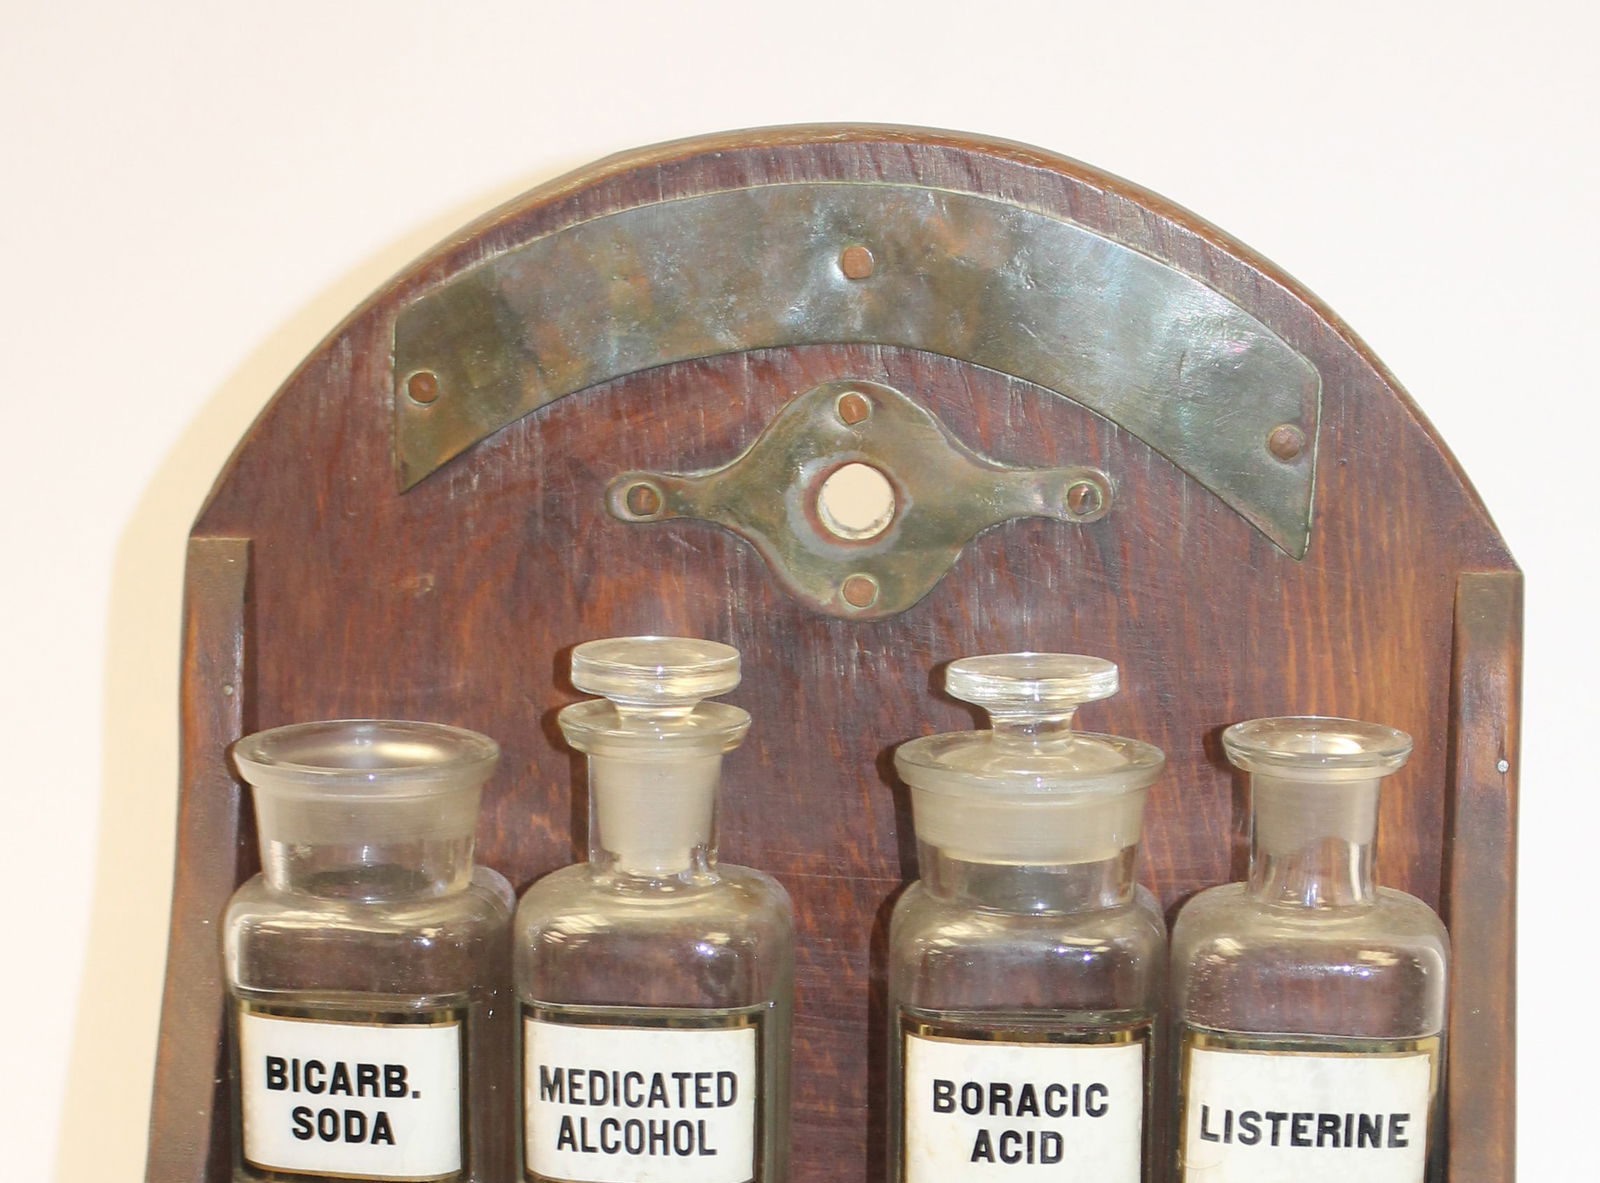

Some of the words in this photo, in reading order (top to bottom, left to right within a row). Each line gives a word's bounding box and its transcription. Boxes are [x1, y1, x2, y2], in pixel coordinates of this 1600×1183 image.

[266, 1056, 420, 1098] BICARB.
[540, 1065, 737, 1108] MEDICATED
[933, 1079, 1108, 1117] BORACIC
[292, 1106, 395, 1145] SODA
[557, 1115, 716, 1156] ALCOHOL
[1201, 1105, 1410, 1148] LISTERINE
[971, 1129, 1063, 1164] ACID
